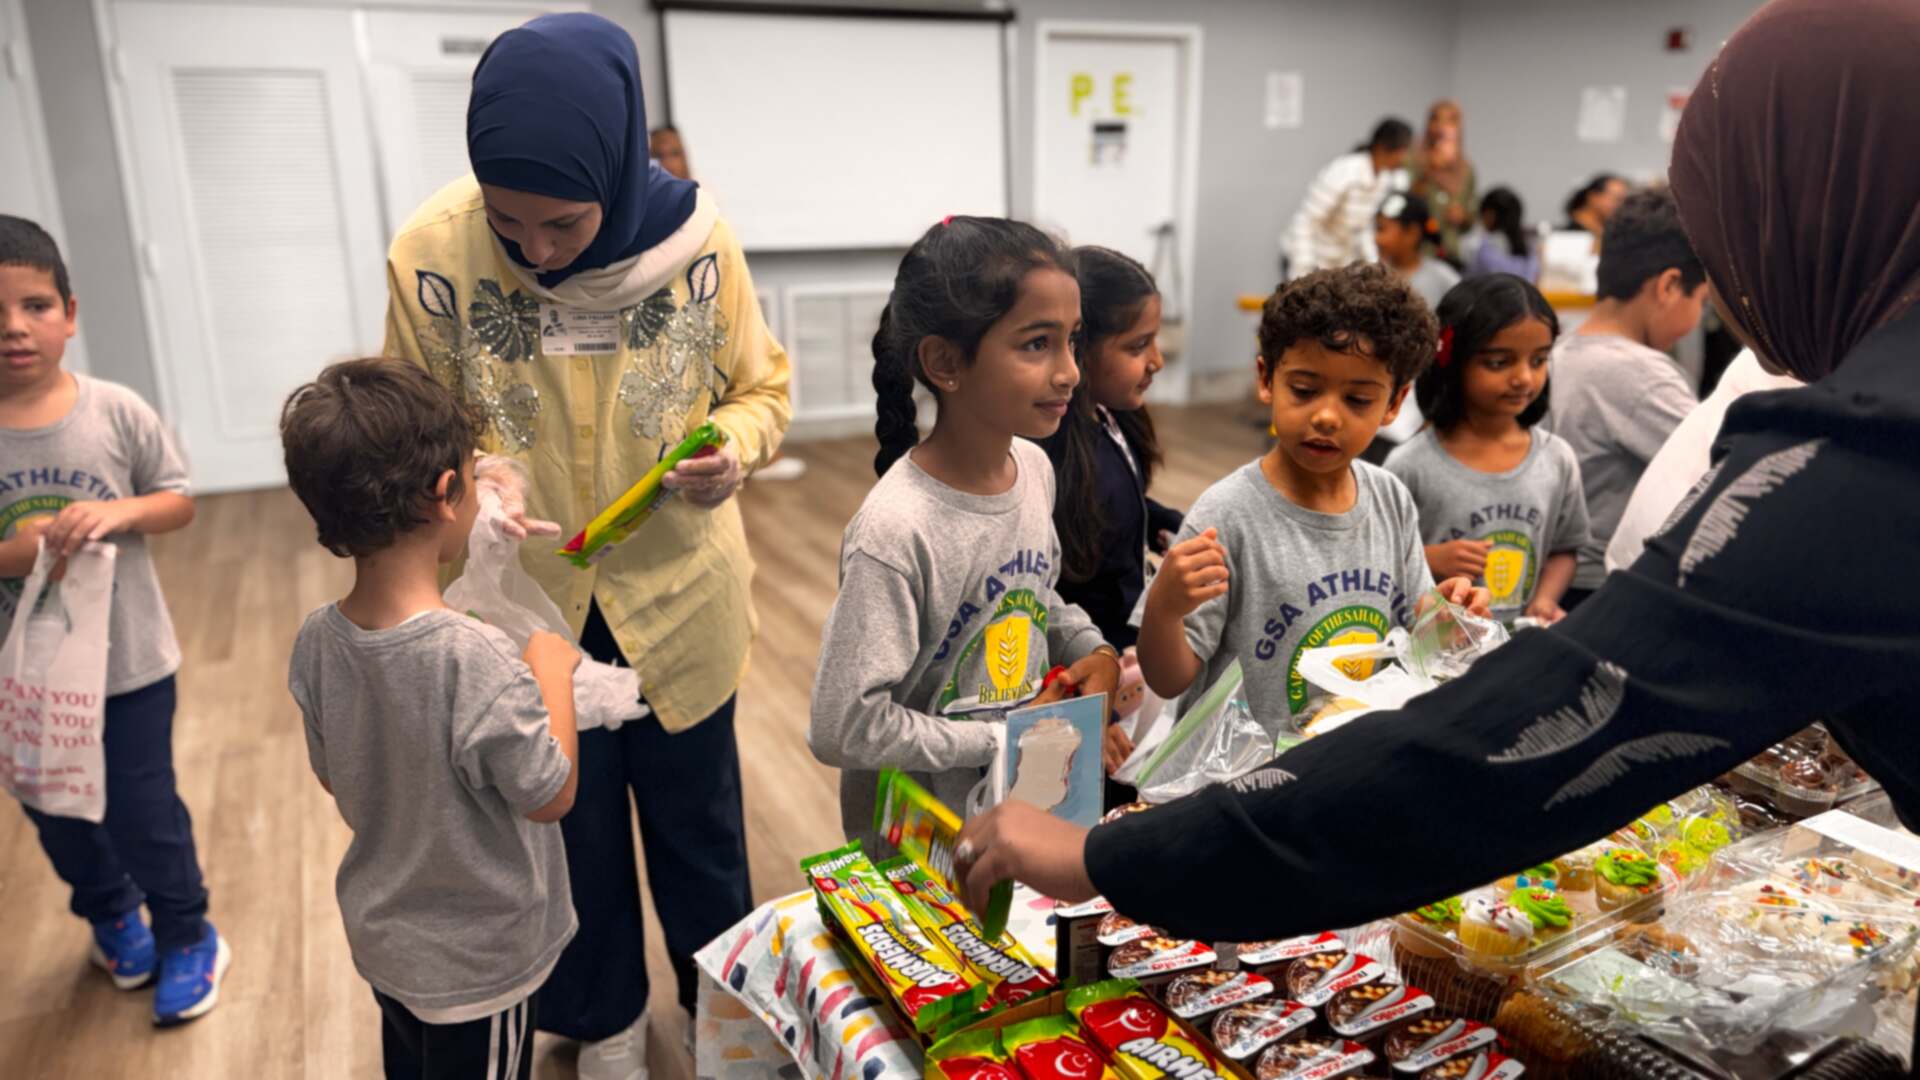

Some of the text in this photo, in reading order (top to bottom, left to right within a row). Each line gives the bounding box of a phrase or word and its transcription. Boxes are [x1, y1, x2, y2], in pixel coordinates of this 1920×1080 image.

[1255, 602, 1304, 661] GSA
[50, 691, 97, 709] YOU
[50, 712, 95, 730] YOU
[50, 734, 95, 750] YOU
[857, 923, 954, 988] AIRHEADS
[940, 923, 1037, 985] AIRHEADS
